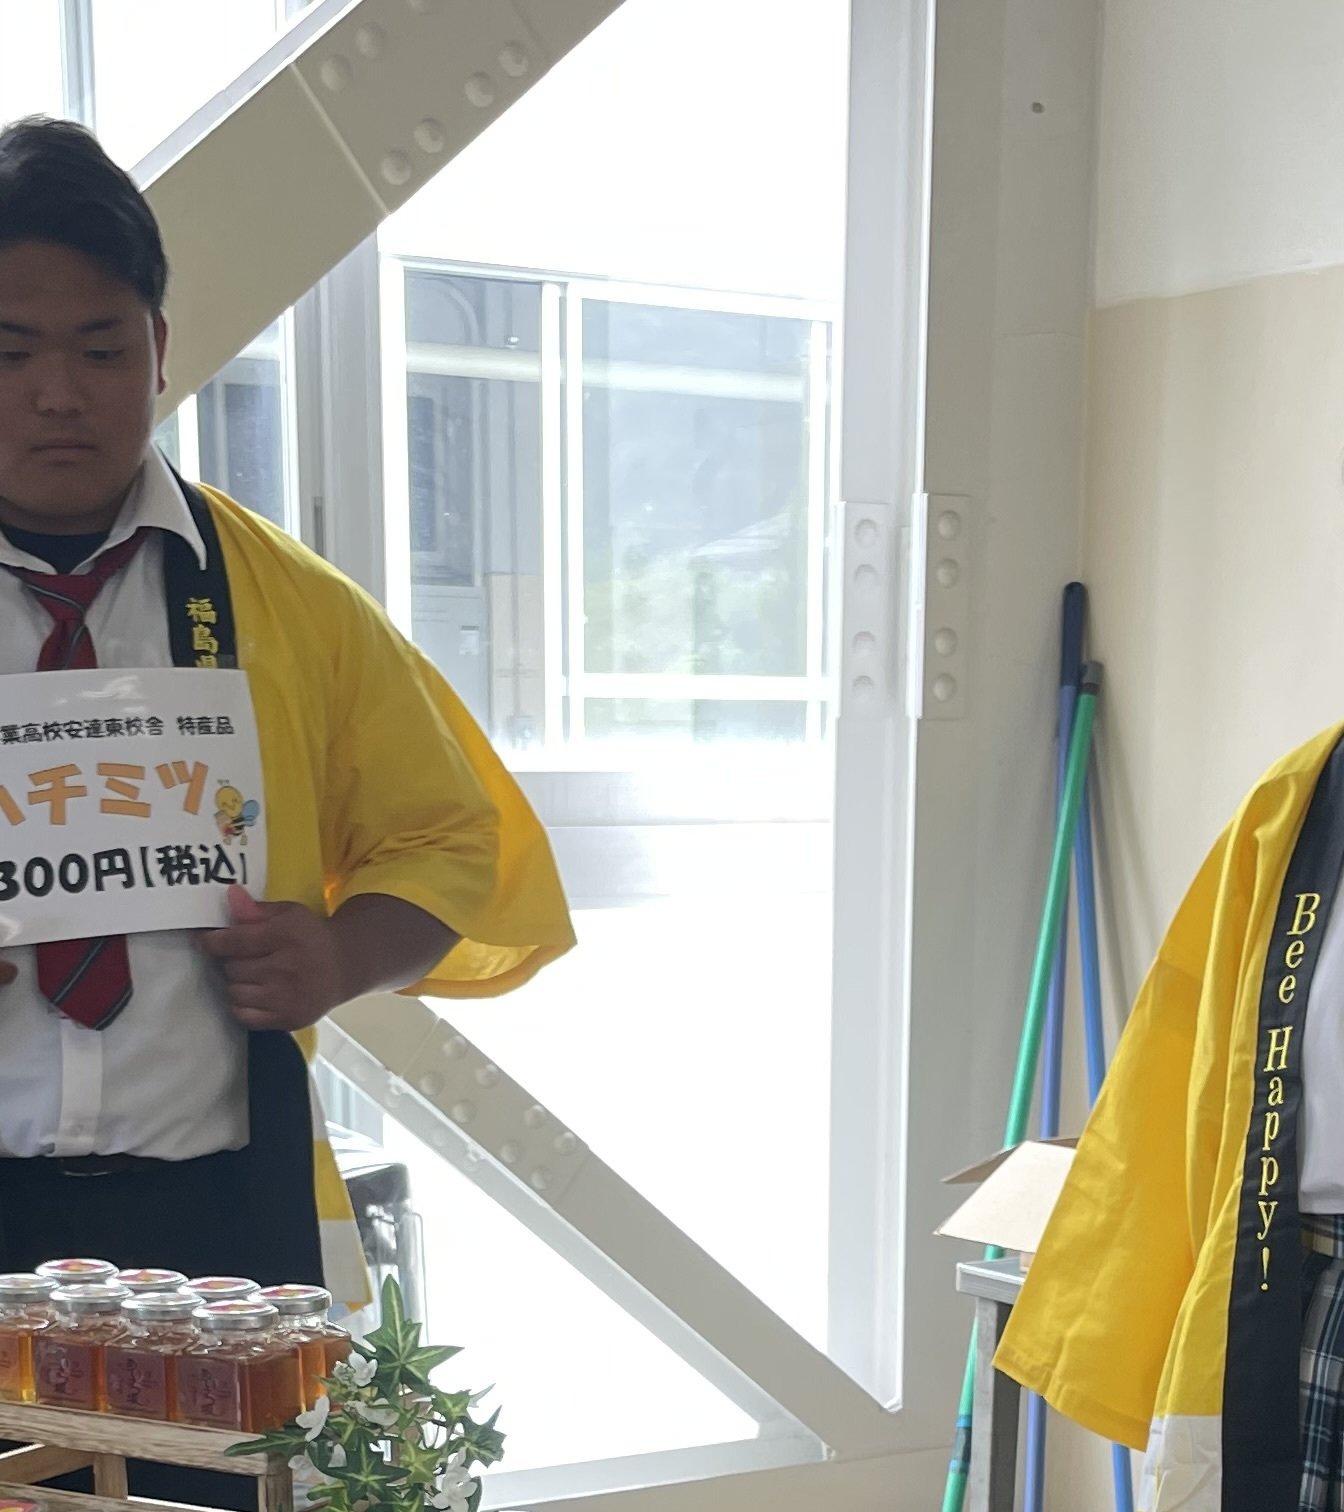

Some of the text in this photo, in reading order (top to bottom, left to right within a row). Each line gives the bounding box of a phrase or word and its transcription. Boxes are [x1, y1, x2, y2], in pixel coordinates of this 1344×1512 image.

[176, 715, 236, 738] 特産品
[1255, 892, 1322, 1292] Bee Happy!
